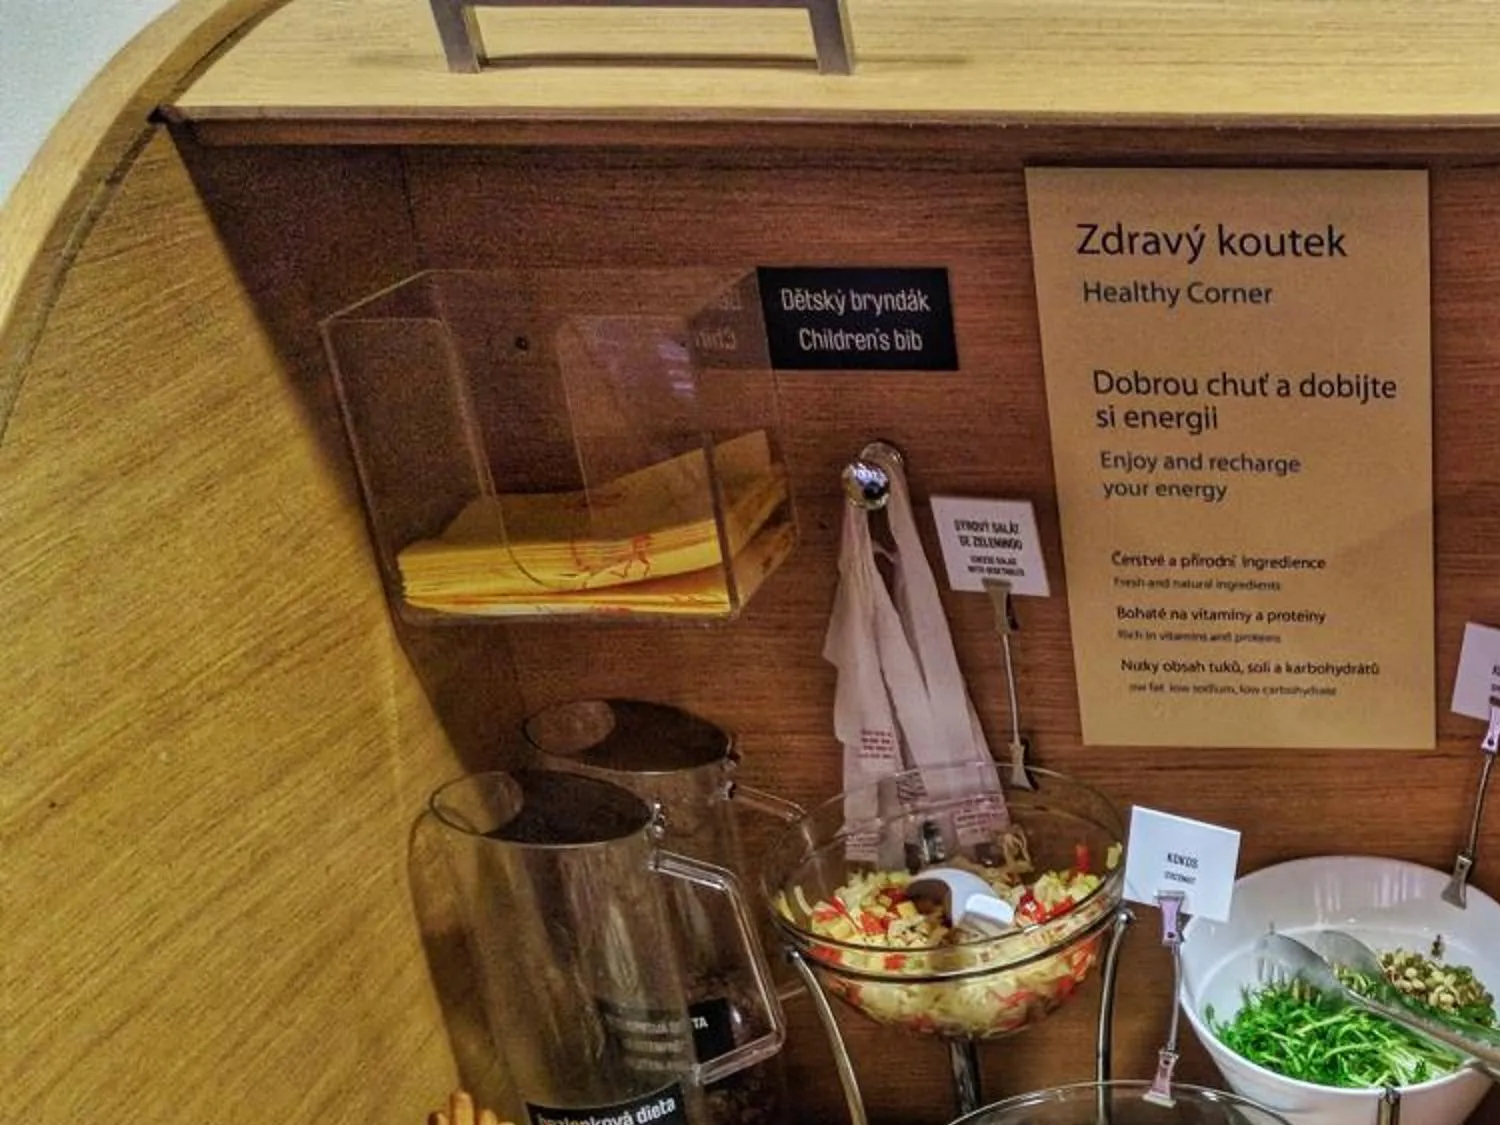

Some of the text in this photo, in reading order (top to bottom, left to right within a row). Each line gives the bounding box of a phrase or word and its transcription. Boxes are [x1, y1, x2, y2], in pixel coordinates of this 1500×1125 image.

[1076, 223, 1347, 264] Zdravý koutek
[781, 288, 931, 317] Dětský bryndák
[1083, 280, 1273, 308] Healthy Corner
[894, 328, 923, 351] bib
[1093, 370, 1397, 405] Dobrou chuť a dobijte
[1096, 406, 1218, 435] si energii
[1101, 451, 1301, 475] Enjoy and recharge
[1104, 482, 1228, 502] your energy
[1169, 556, 1177, 567] a
[1242, 556, 1327, 571] ingredience
[1117, 605, 1167, 621] Bohaté
[1170, 609, 1188, 620] na
[1256, 611, 1265, 621] a
[1267, 609, 1327, 624] proteiny
[1163, 660, 1206, 673] obsah
[636, 1097, 676, 1124] dieta
